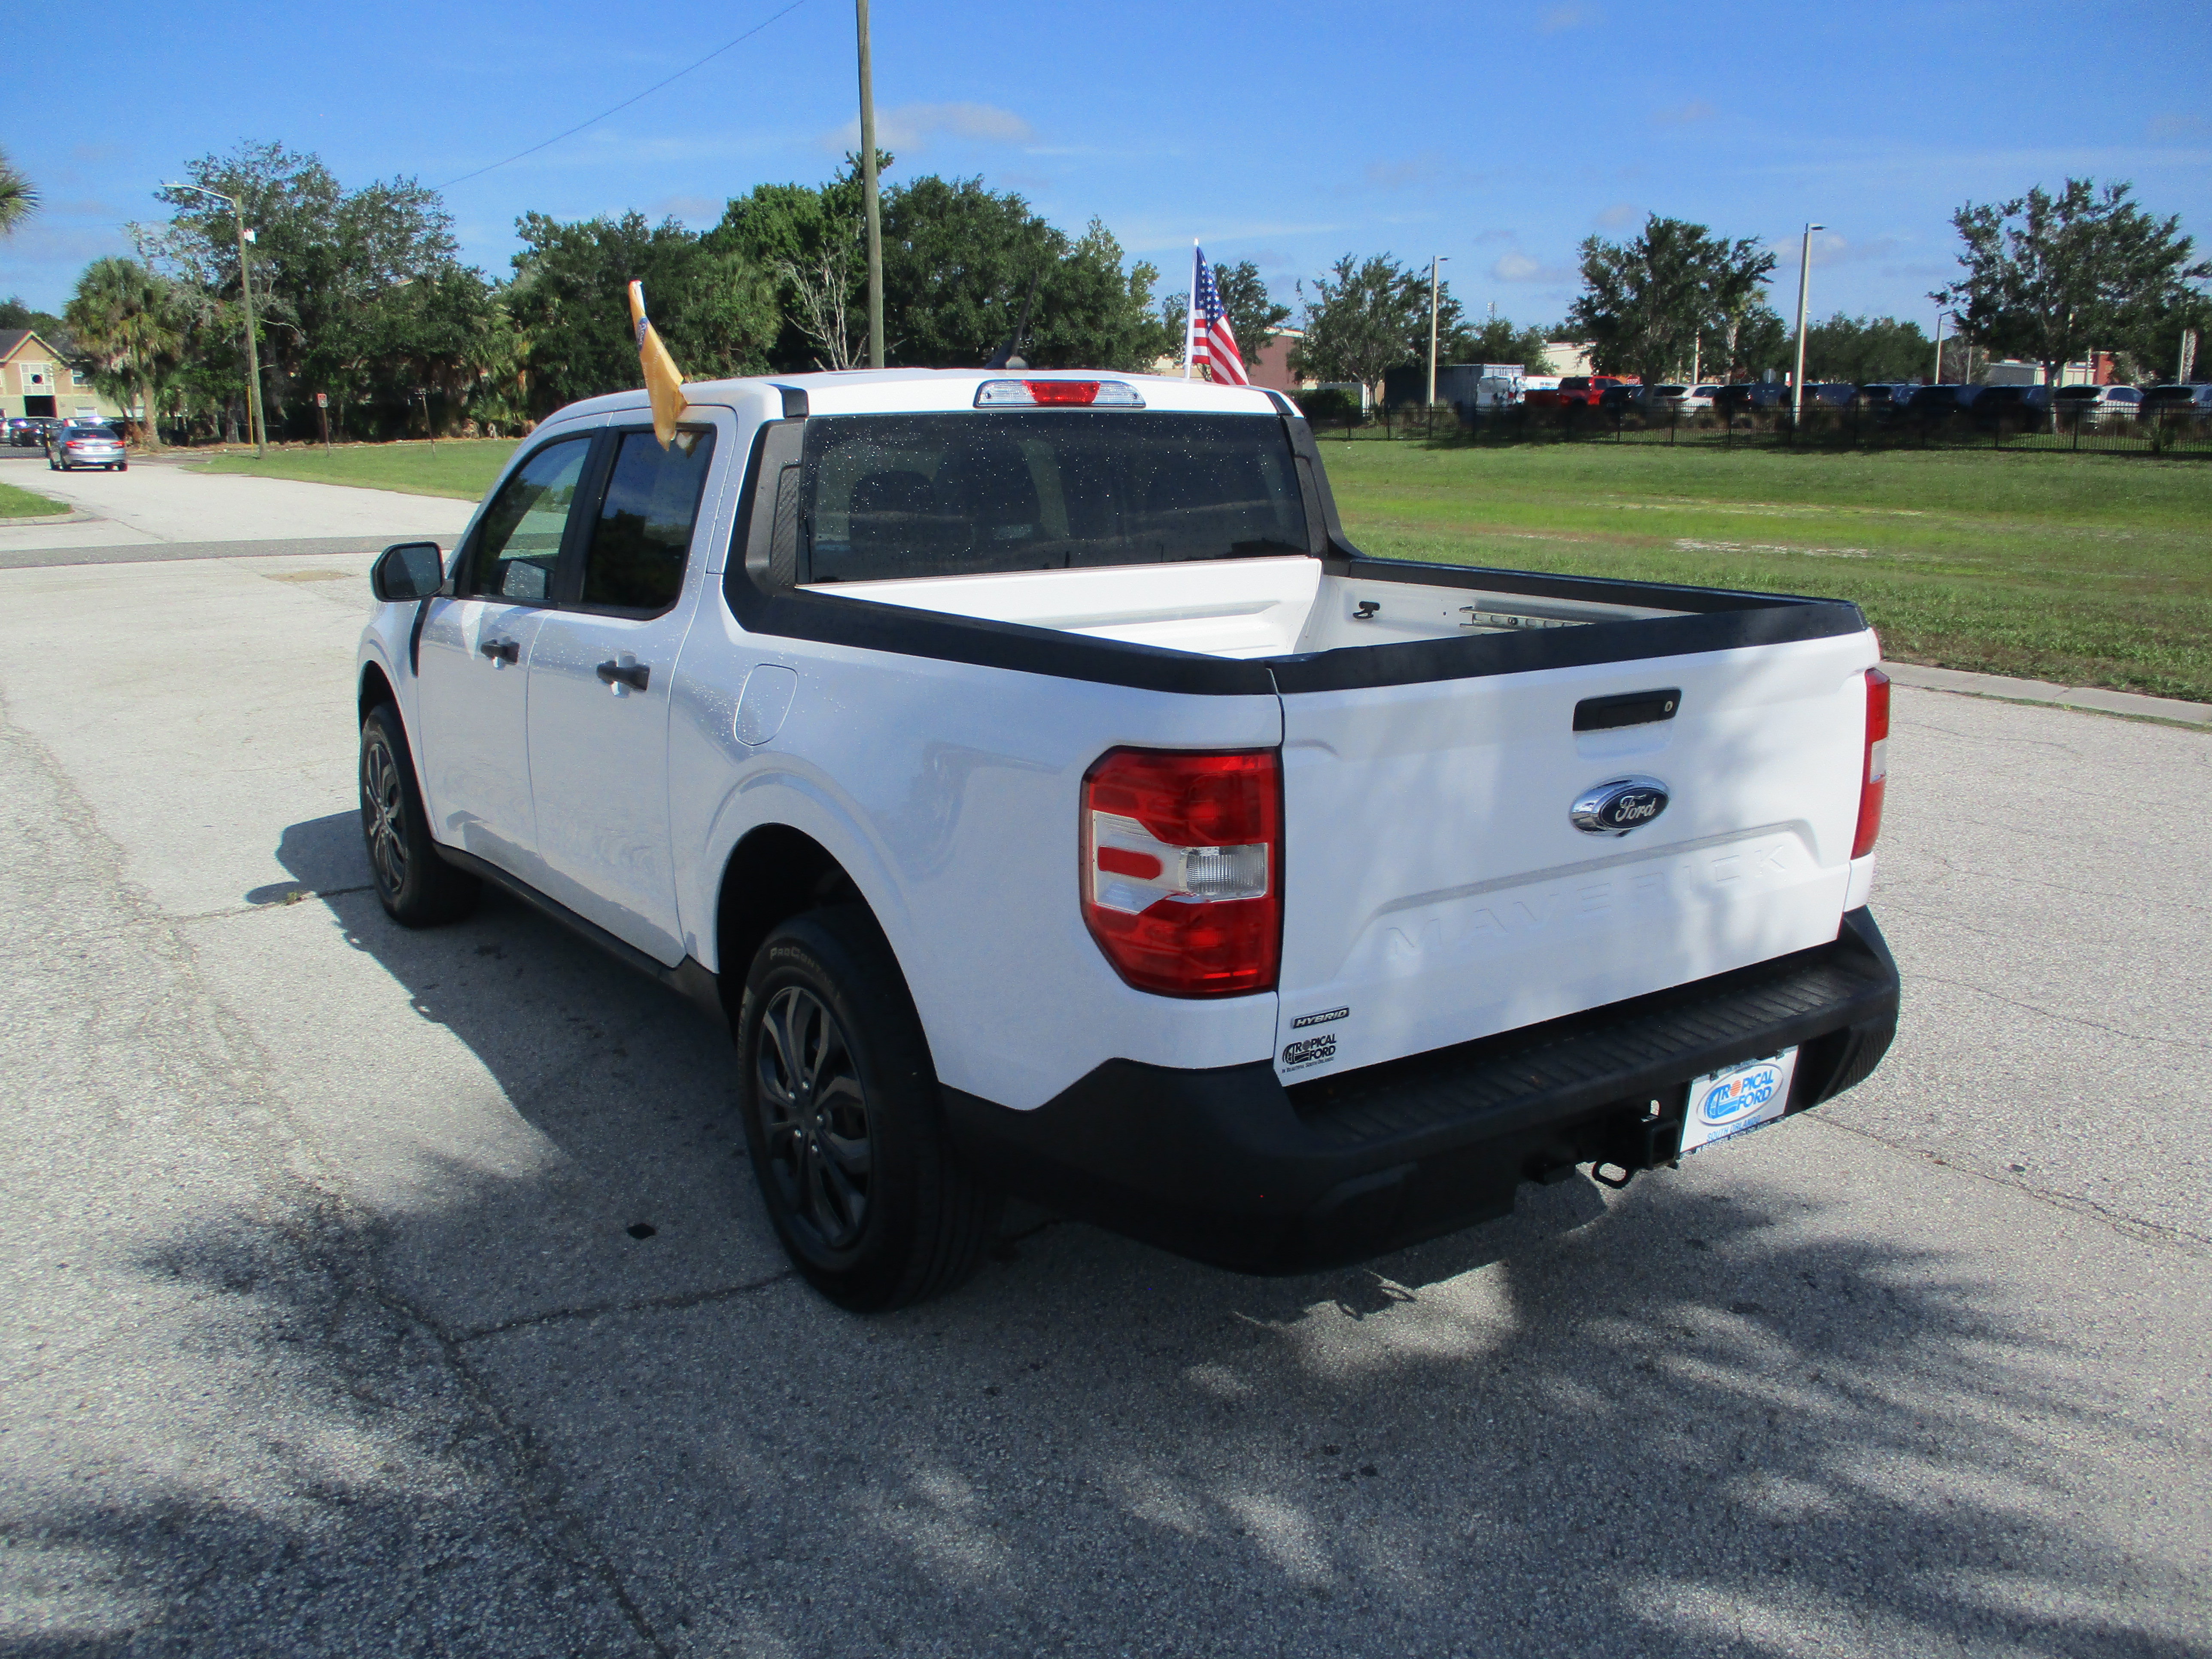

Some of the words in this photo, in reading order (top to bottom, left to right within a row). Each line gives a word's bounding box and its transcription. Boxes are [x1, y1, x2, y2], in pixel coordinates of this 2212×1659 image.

[1615, 794, 1656, 822] Ford
[1385, 844, 1787, 960] MAVERICK
[1295, 1009, 1348, 1027] HYBRID
[1310, 1045, 1336, 1060] FORD
[1737, 1086, 1772, 1110] FORD
[1707, 1127, 1729, 1142] SOUTH
